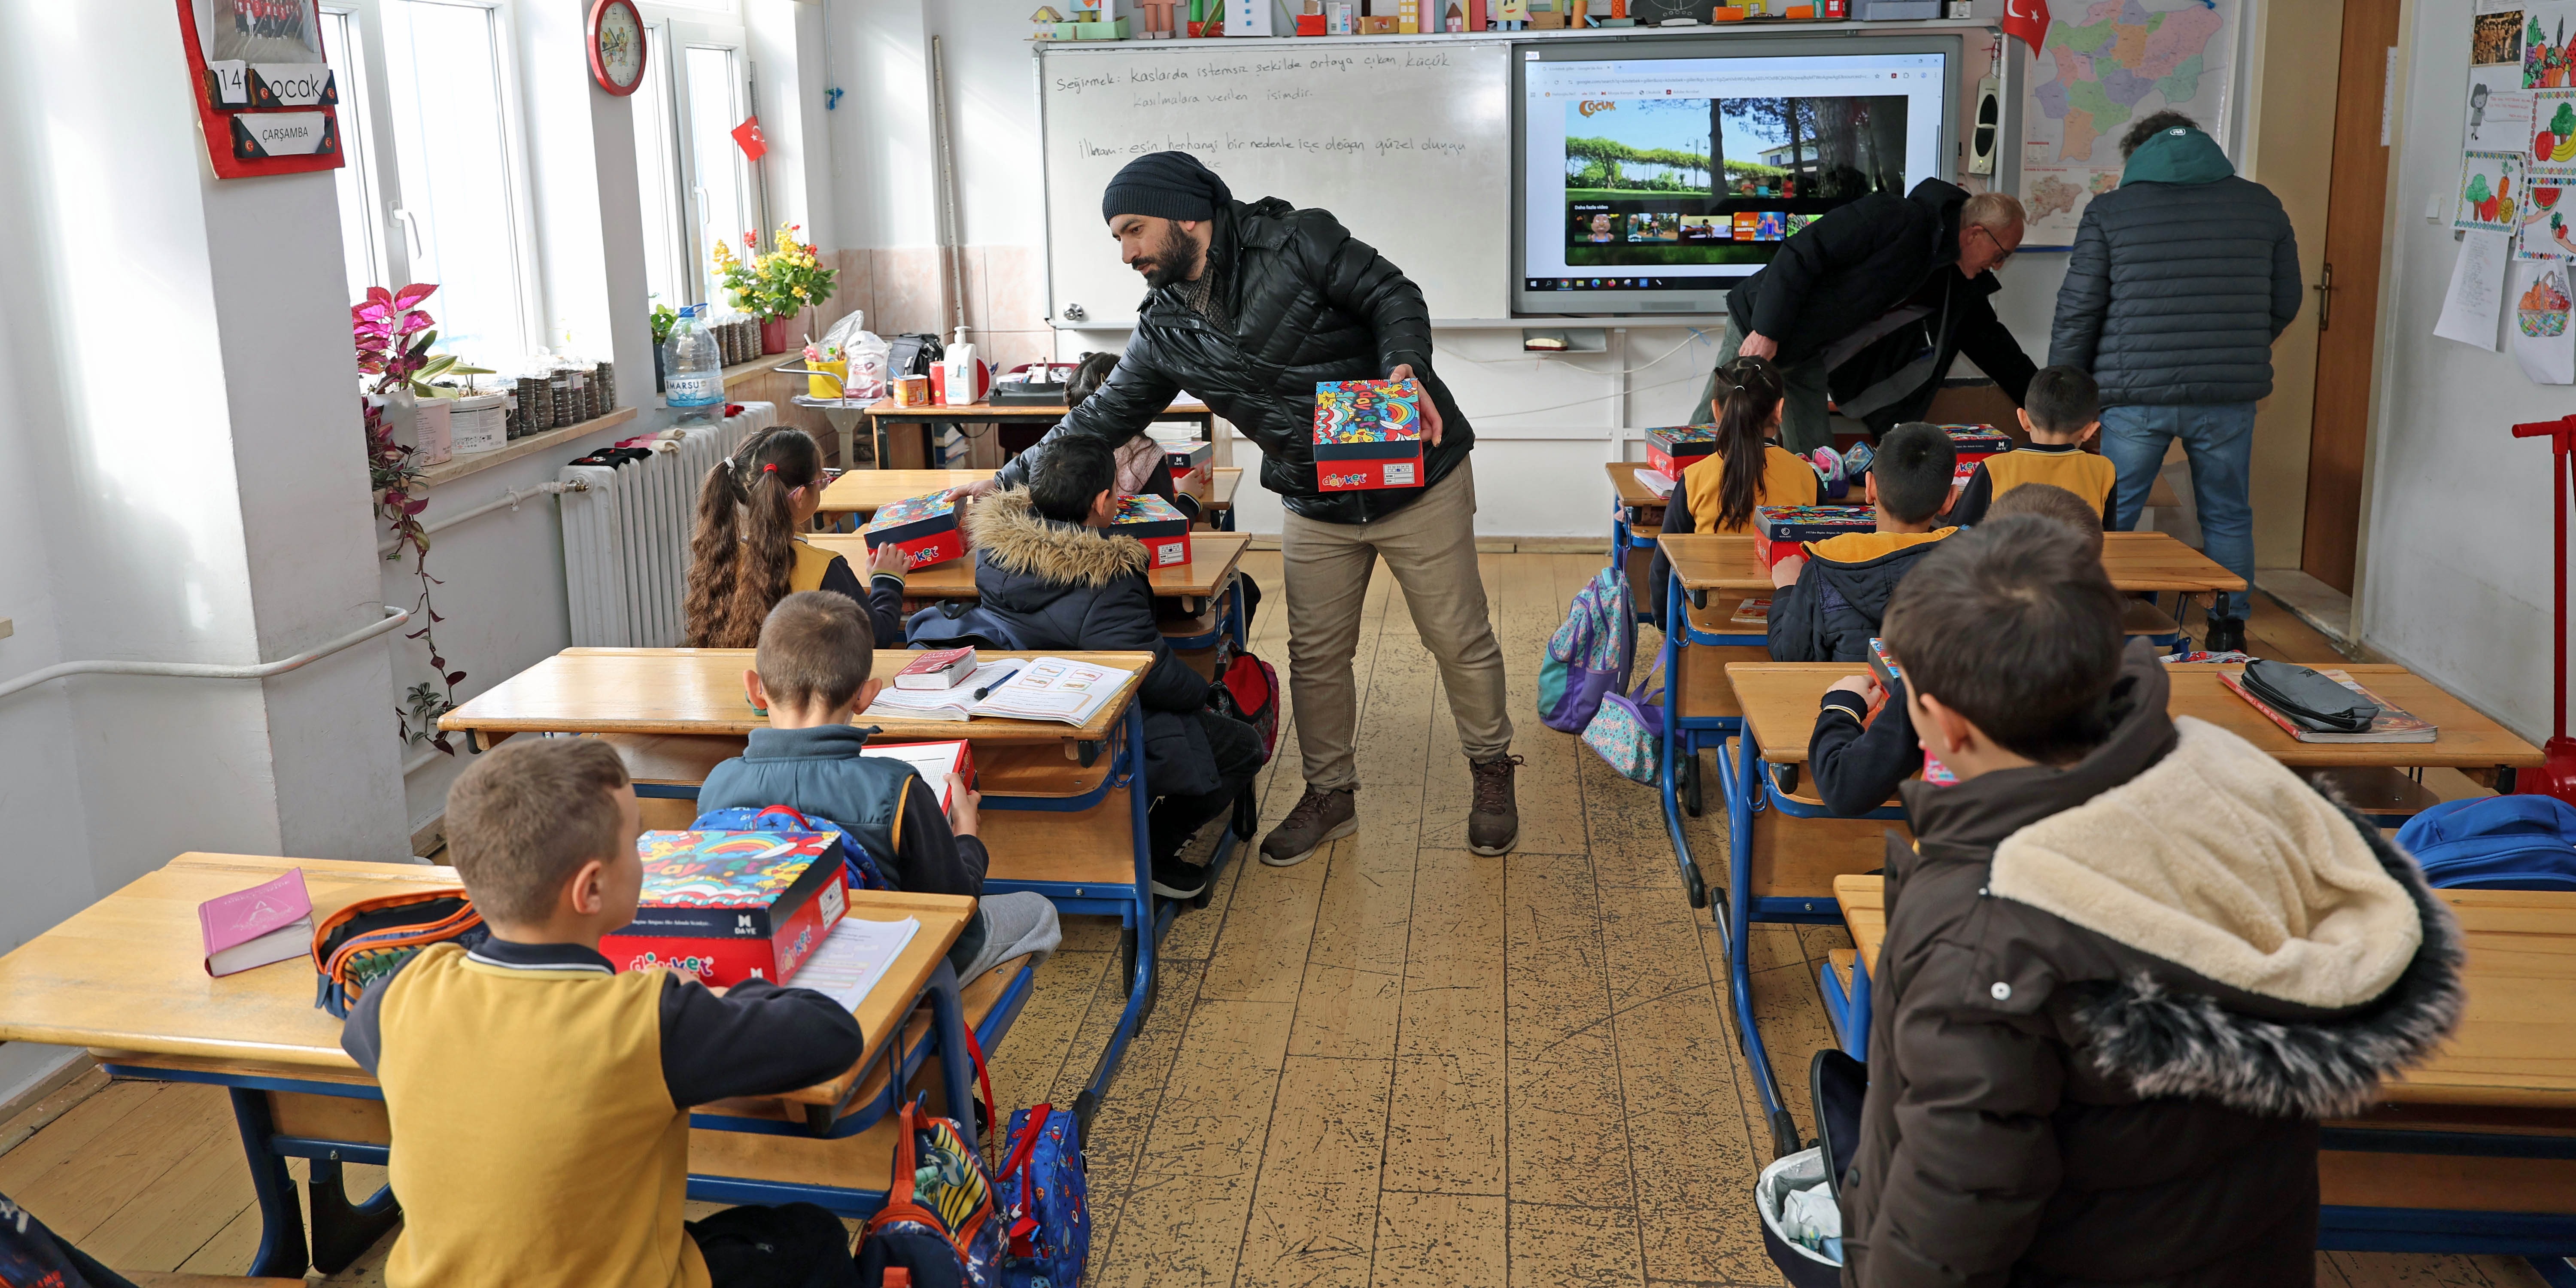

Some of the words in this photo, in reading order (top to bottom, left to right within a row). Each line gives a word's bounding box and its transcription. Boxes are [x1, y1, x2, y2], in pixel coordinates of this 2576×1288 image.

[1310, 54, 1354, 72] ortaya
[220, 68, 242, 91] 14
[271, 73, 322, 98] ocak
[262, 126, 308, 143] ÇARŞAMBA
[1226, 132, 1245, 150] bir
[1422, 137, 1466, 155] duygu
[670, 381, 699, 389] MARSU
[1322, 474, 1367, 487] dayket
